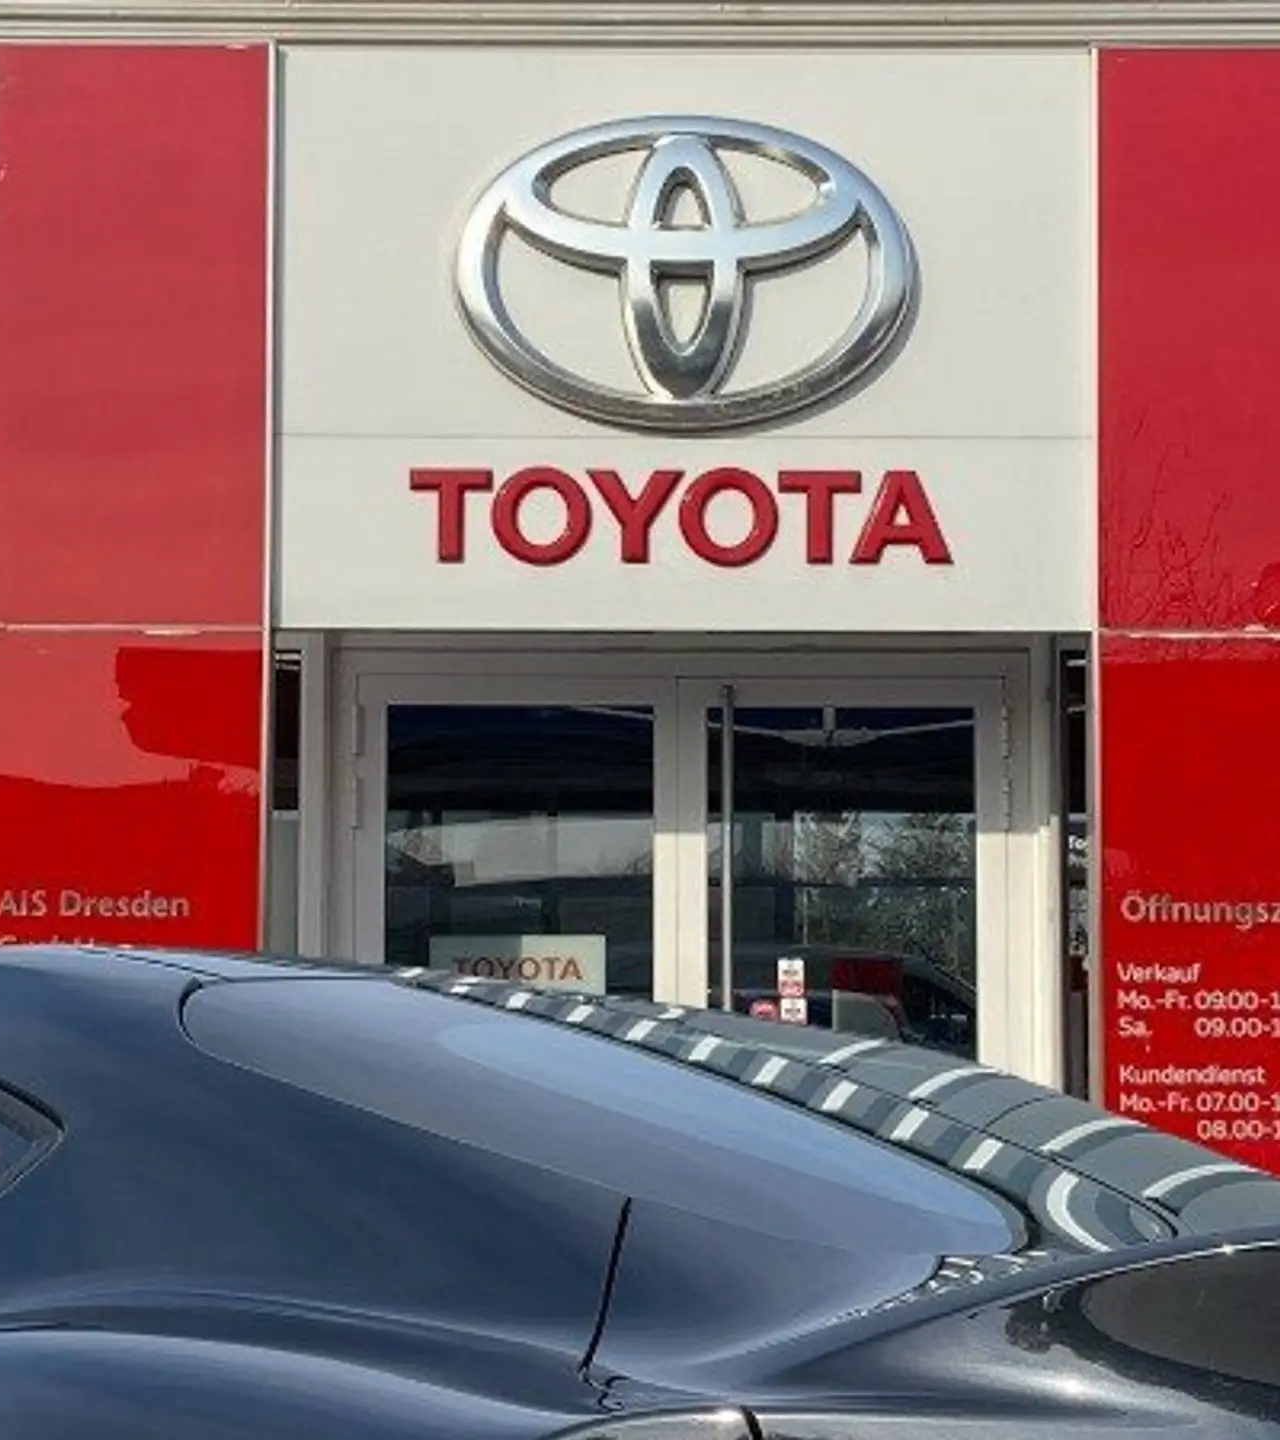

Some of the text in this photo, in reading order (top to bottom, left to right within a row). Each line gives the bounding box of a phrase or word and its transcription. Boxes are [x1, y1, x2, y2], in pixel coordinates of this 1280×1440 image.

[409, 466, 955, 567] TOYOTA
[59, 889, 190, 917] Dresden
[454, 957, 582, 980] TOYOTA
[1117, 962, 1201, 982] Verkauf
[1117, 990, 1191, 1010] Mo.-Fr.
[1117, 1015, 1153, 1037] Sa.
[1119, 1065, 1266, 1086] Kundendienst
[1119, 1092, 1191, 1112] Mo.-Fr.
